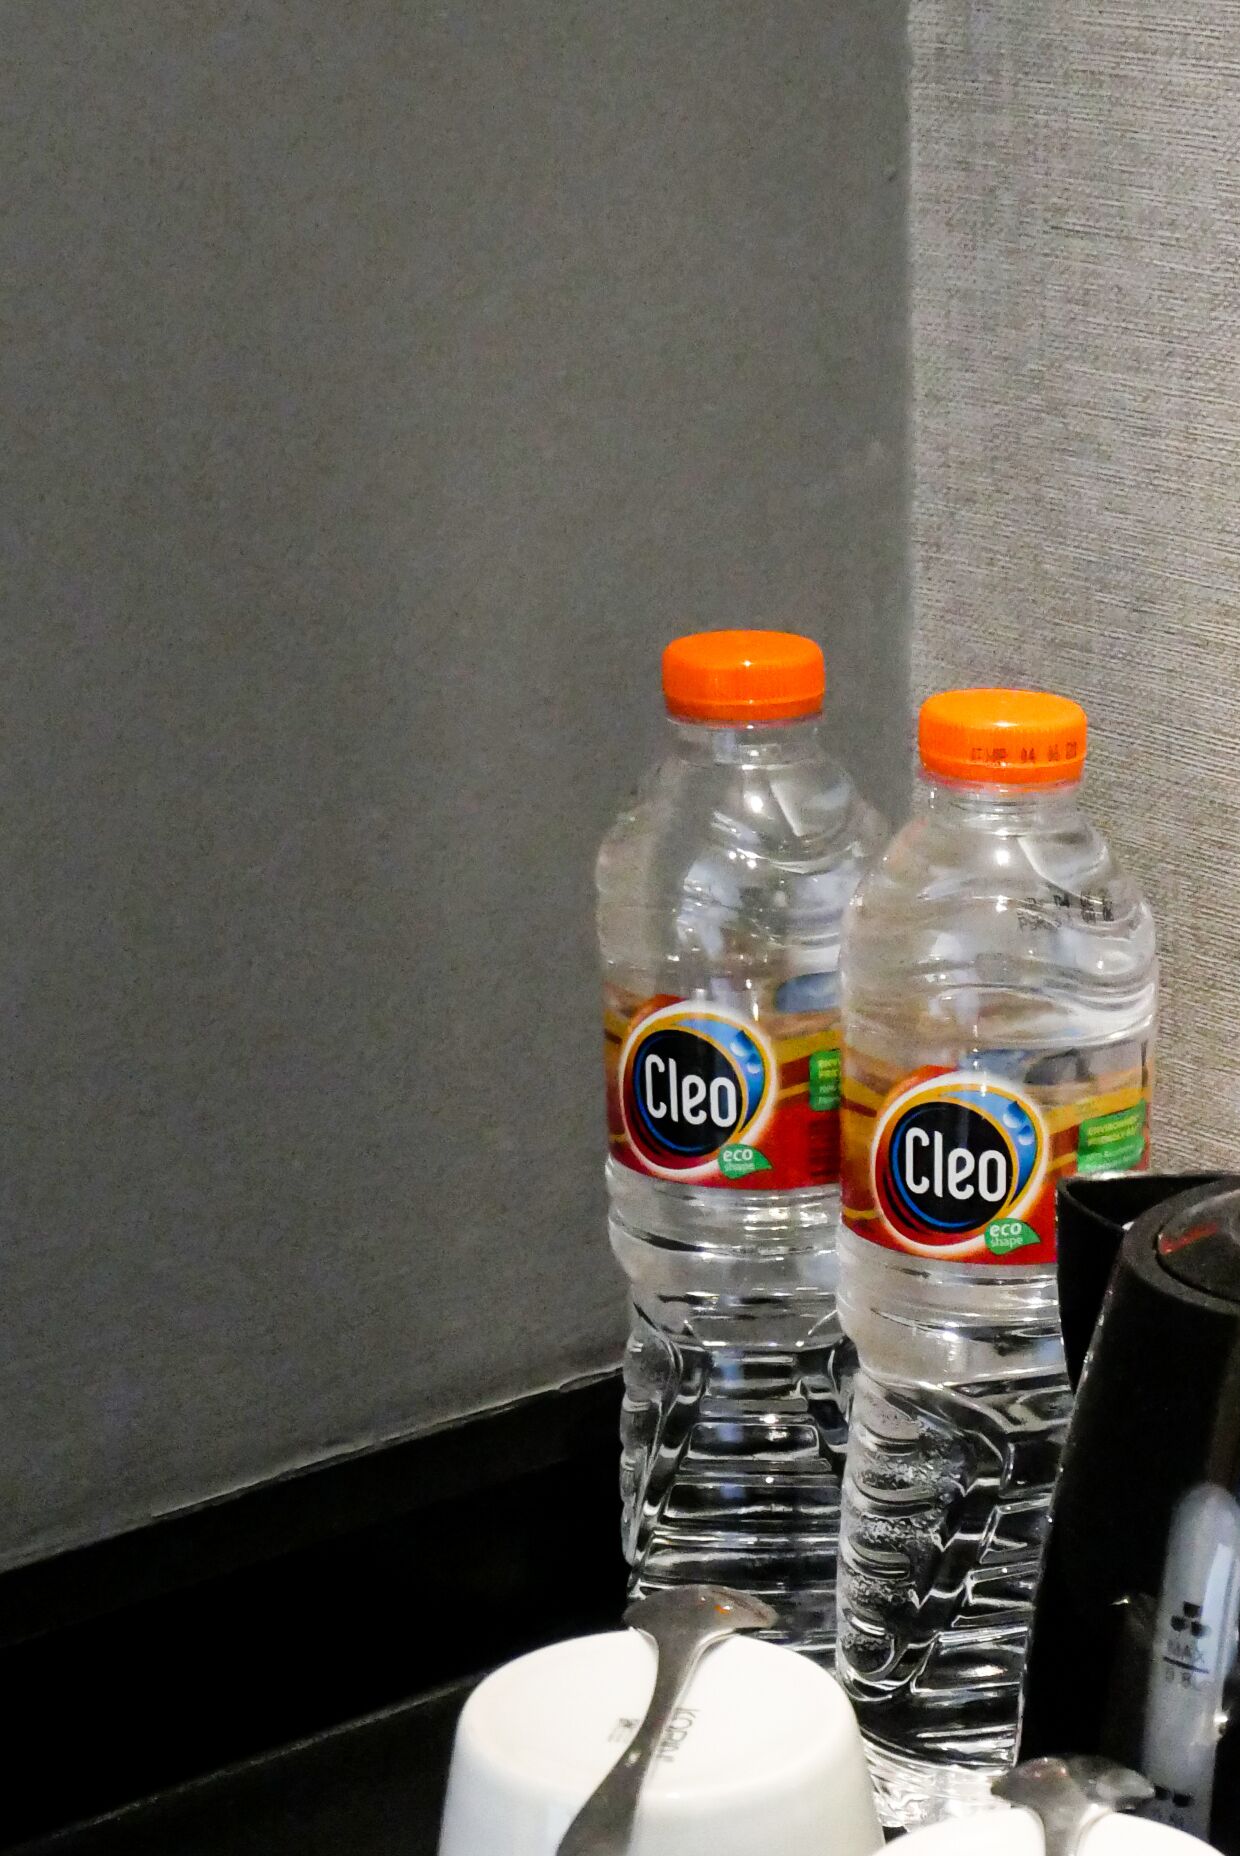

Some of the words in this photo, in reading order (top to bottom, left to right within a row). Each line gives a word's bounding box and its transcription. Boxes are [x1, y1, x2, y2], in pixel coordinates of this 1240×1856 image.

[645, 1053, 738, 1128] Cleo
[722, 1148, 753, 1162] eco
[905, 1127, 1008, 1203] Cleo
[989, 1222, 1022, 1237] eco
